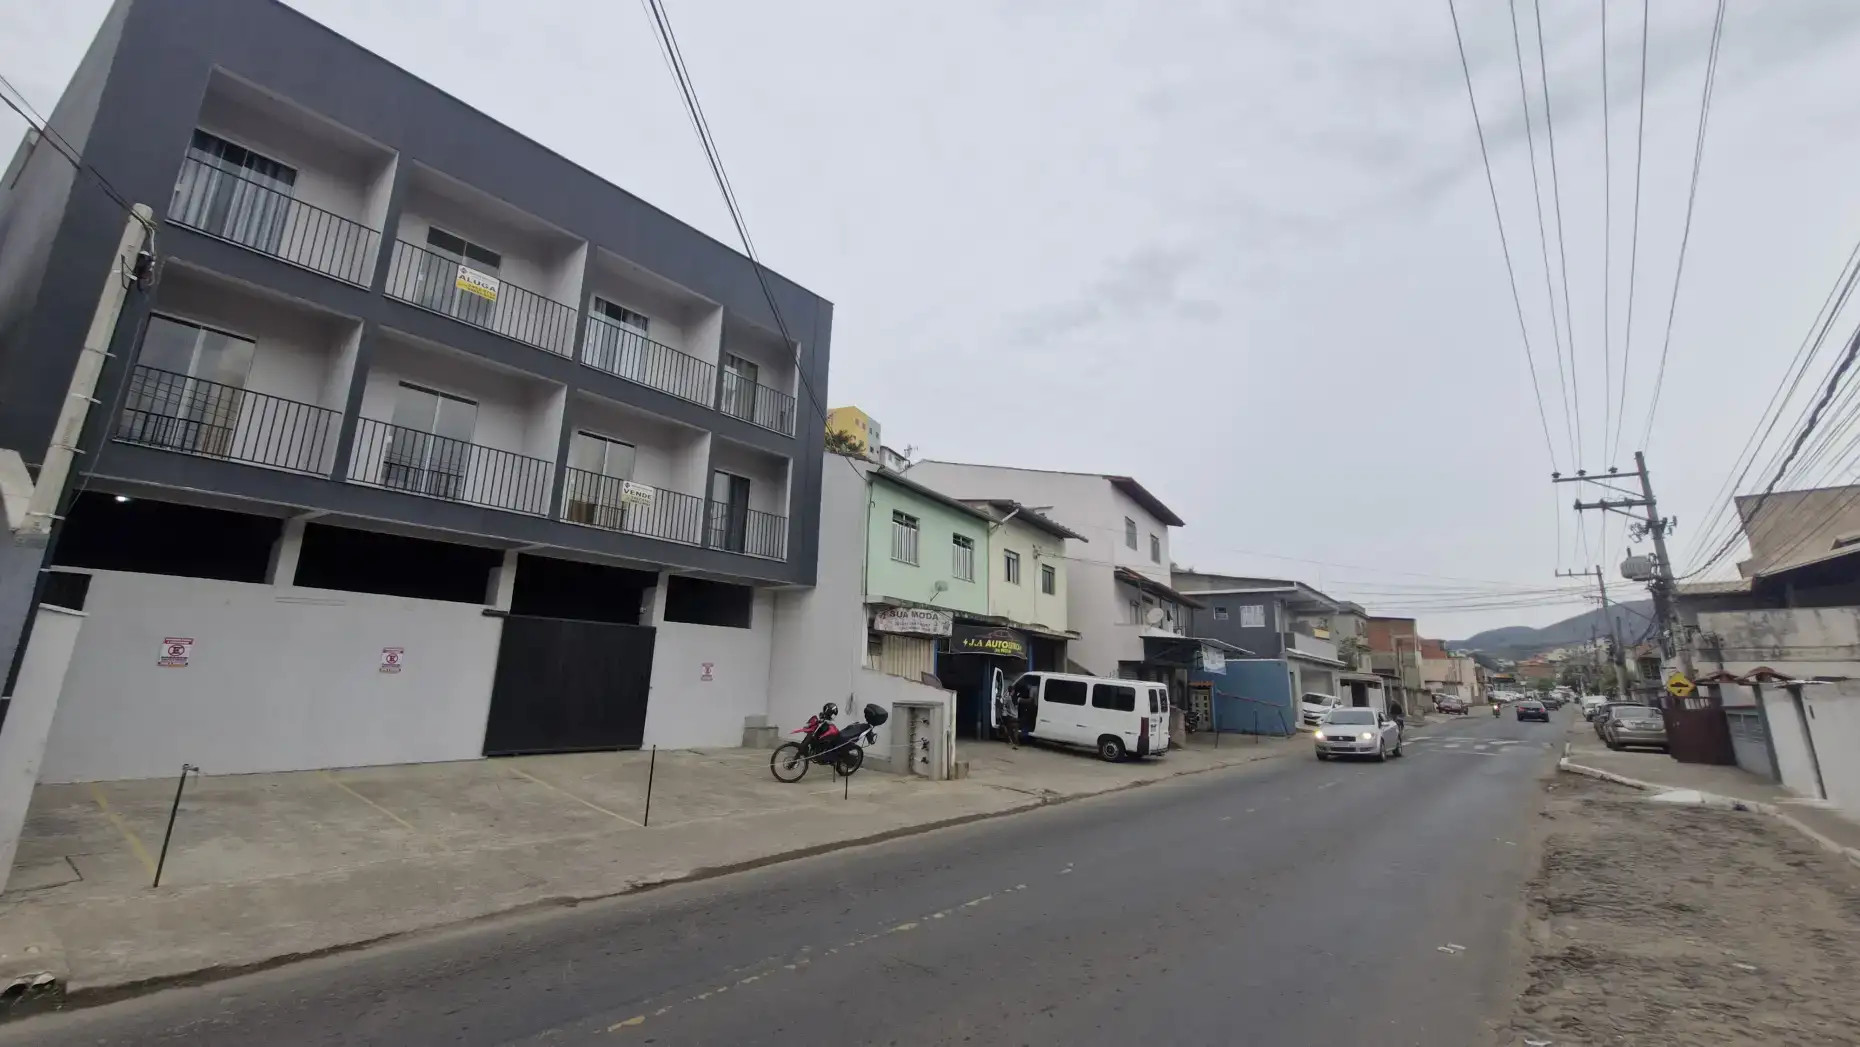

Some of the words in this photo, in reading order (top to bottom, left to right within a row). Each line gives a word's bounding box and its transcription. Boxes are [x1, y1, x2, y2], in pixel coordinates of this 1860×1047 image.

[459, 274, 496, 292] ALUGA
[623, 488, 652, 500] VENDE
[889, 610, 909, 618] SUA
[911, 610, 939, 620] MODA
